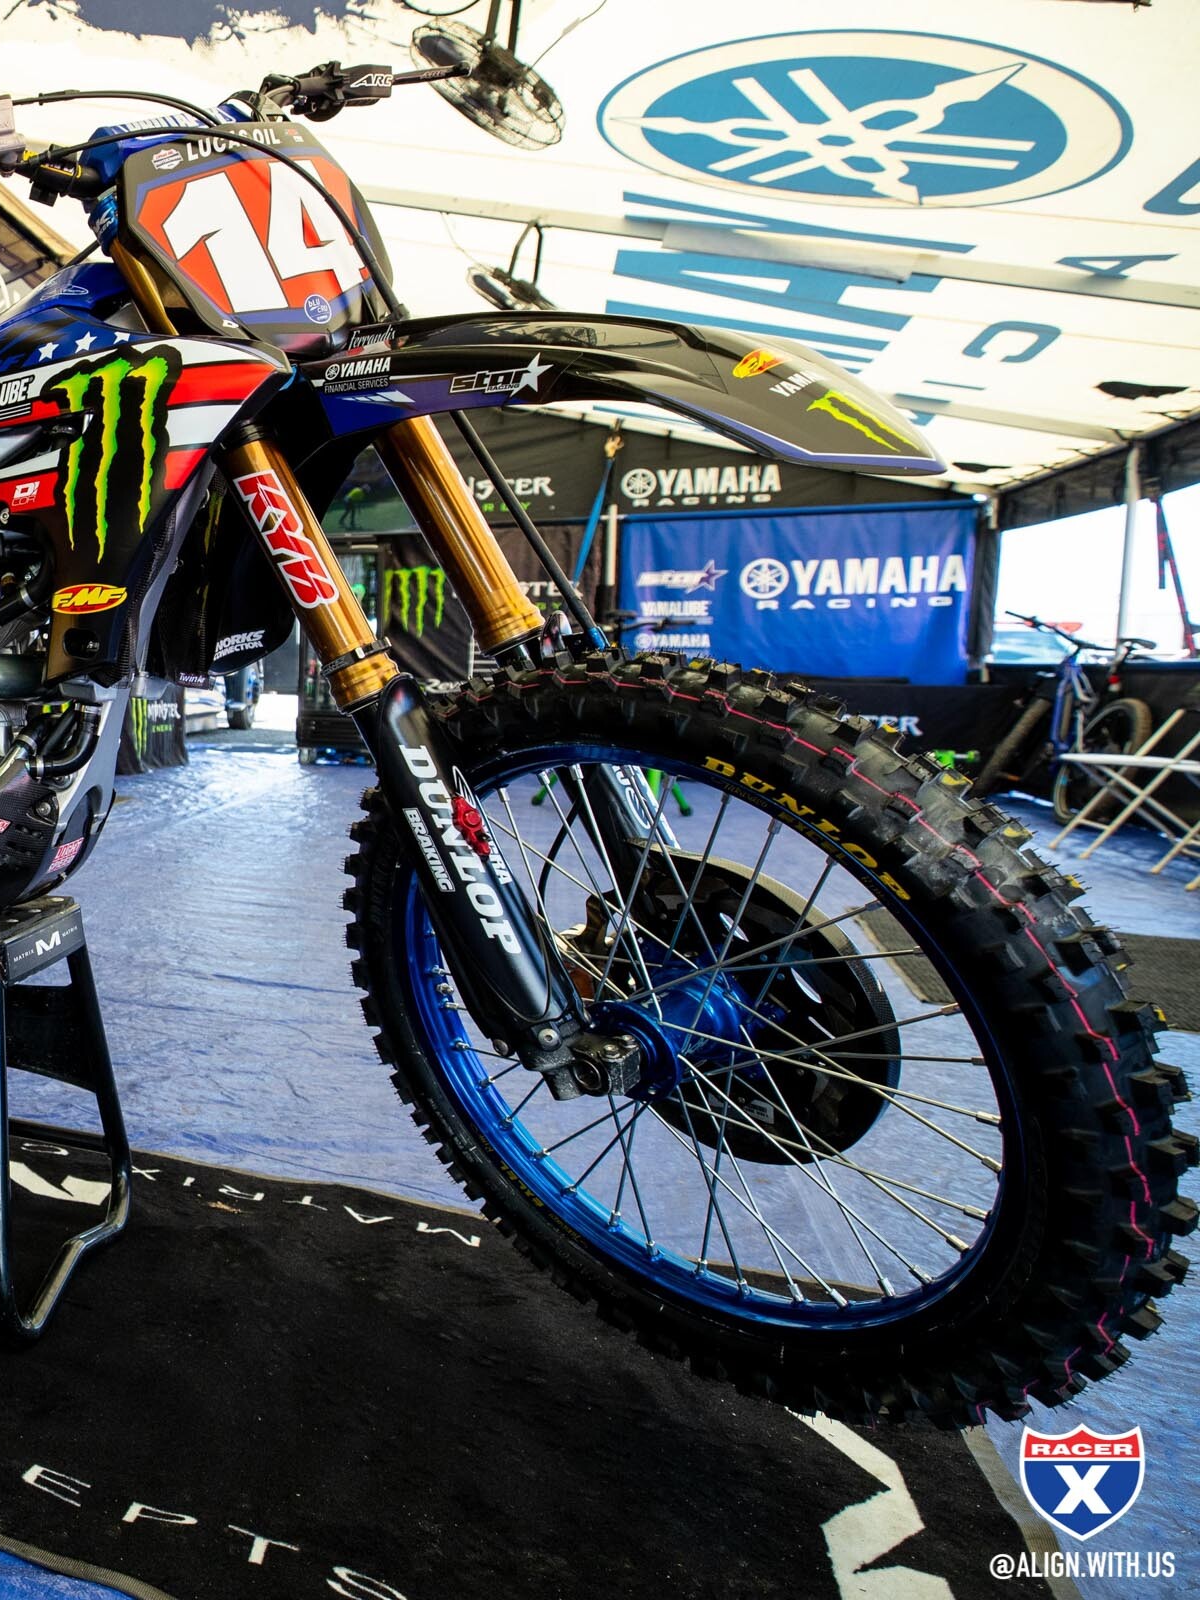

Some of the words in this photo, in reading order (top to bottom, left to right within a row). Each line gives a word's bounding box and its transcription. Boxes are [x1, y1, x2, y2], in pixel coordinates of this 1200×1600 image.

[350, 73, 394, 88] ARC
[256, 128, 281, 146] OIL
[162, 159, 367, 313] 14
[348, 324, 396, 350] Ferrandis
[340, 357, 392, 378] YAMAHA
[324, 381, 356, 393] FINANCIAL
[357, 377, 389, 389] SERVICES
[487, 382, 520, 392] RACING
[657, 464, 782, 496] YAMAHA
[633, 493, 771, 507] RACING
[233, 469, 339, 609] KYB
[791, 555, 967, 596] YAMAHA
[53, 586, 127, 610] FMF
[757, 596, 953, 610] RACING
[652, 633, 711, 648] YAMAHA
[700, 756, 911, 901] DUNLOP
[398, 744, 522, 955] DUNLOP
[404, 808, 454, 892] BRAKING
[13, 948, 35, 962] MATRIX
